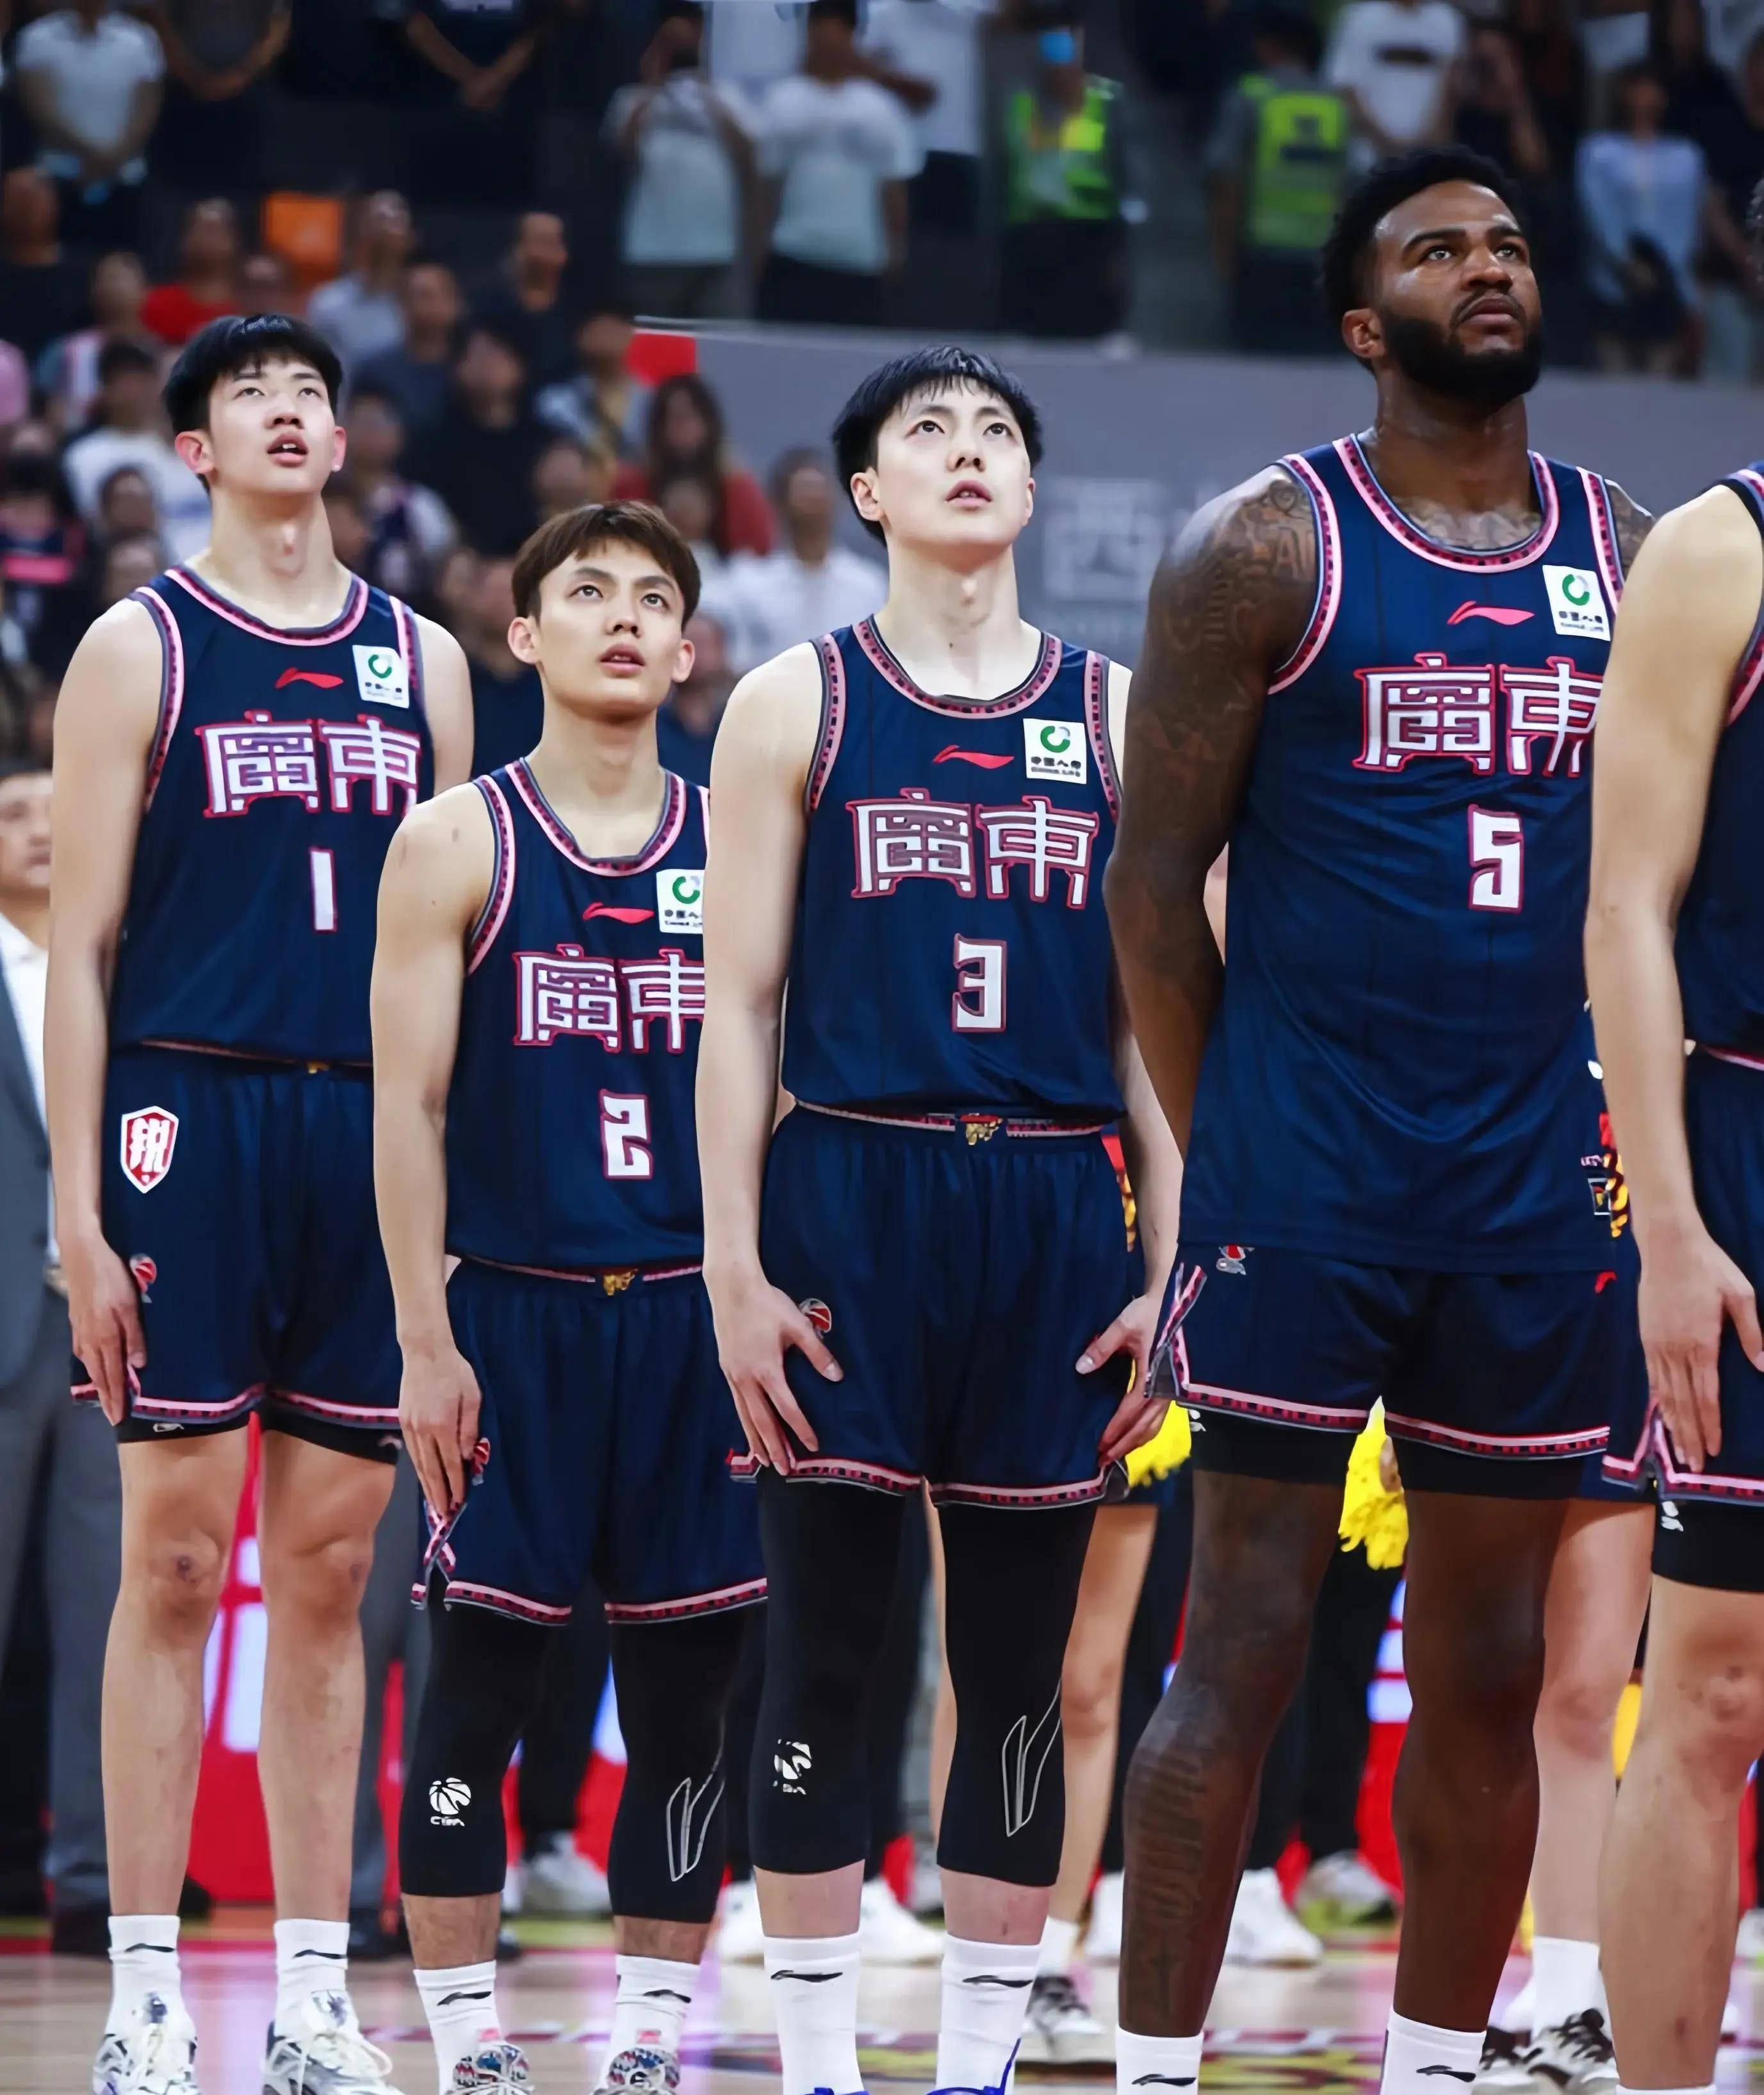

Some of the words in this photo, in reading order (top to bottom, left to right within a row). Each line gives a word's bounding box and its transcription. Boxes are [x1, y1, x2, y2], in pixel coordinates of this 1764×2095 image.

[195, 710, 421, 817] 廣東
[1353, 652, 1604, 778] 廣東
[310, 848, 337, 932] 1
[847, 788, 1099, 909] 廣東
[1469, 804, 1523, 913] 5
[514, 944, 705, 1053] 廣東
[953, 933, 1007, 1033] 3
[600, 1089, 653, 1179] 2
